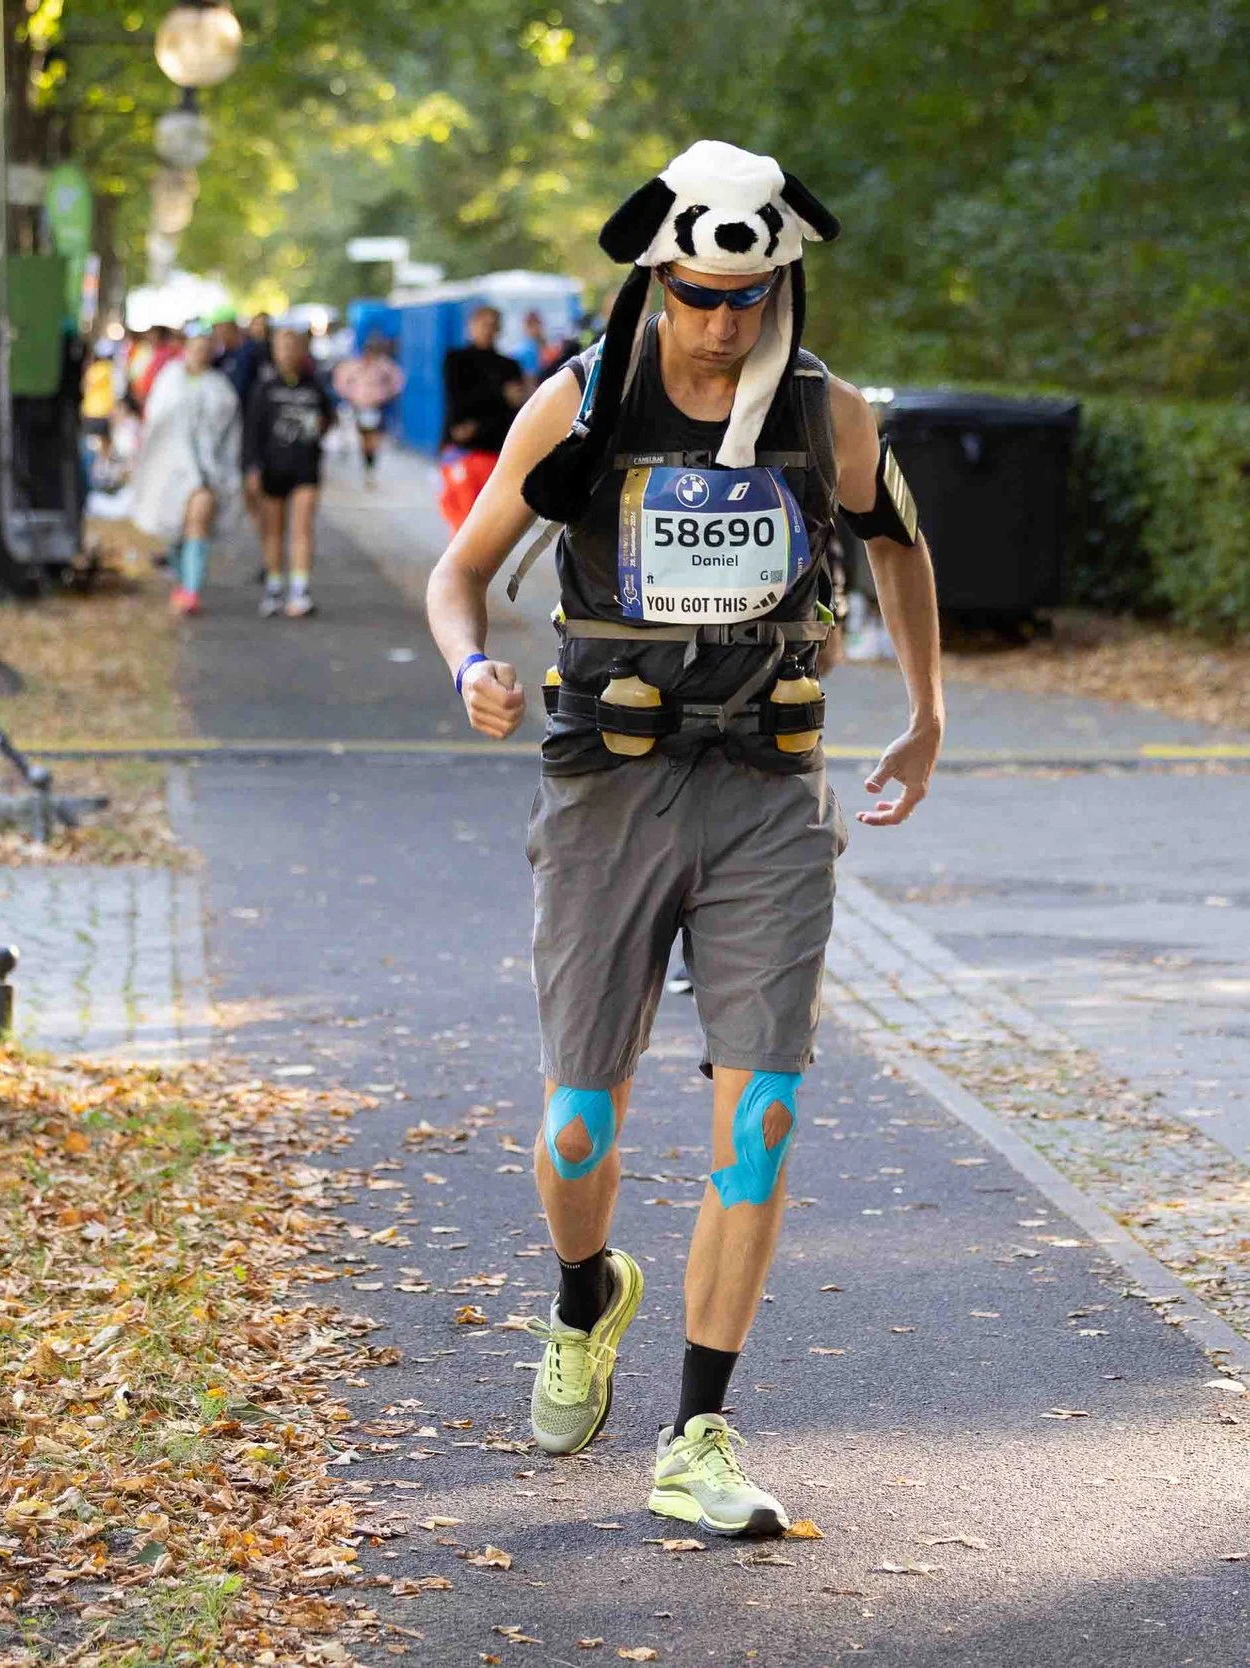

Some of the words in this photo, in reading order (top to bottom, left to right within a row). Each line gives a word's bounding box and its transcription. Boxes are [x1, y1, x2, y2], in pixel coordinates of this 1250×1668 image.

[654, 516, 775, 548] 58690
[692, 554, 739, 567] Daniel
[760, 571, 769, 581] G
[646, 595, 675, 613] YOU
[680, 597, 711, 613] GOT
[713, 597, 748, 613] THIS
